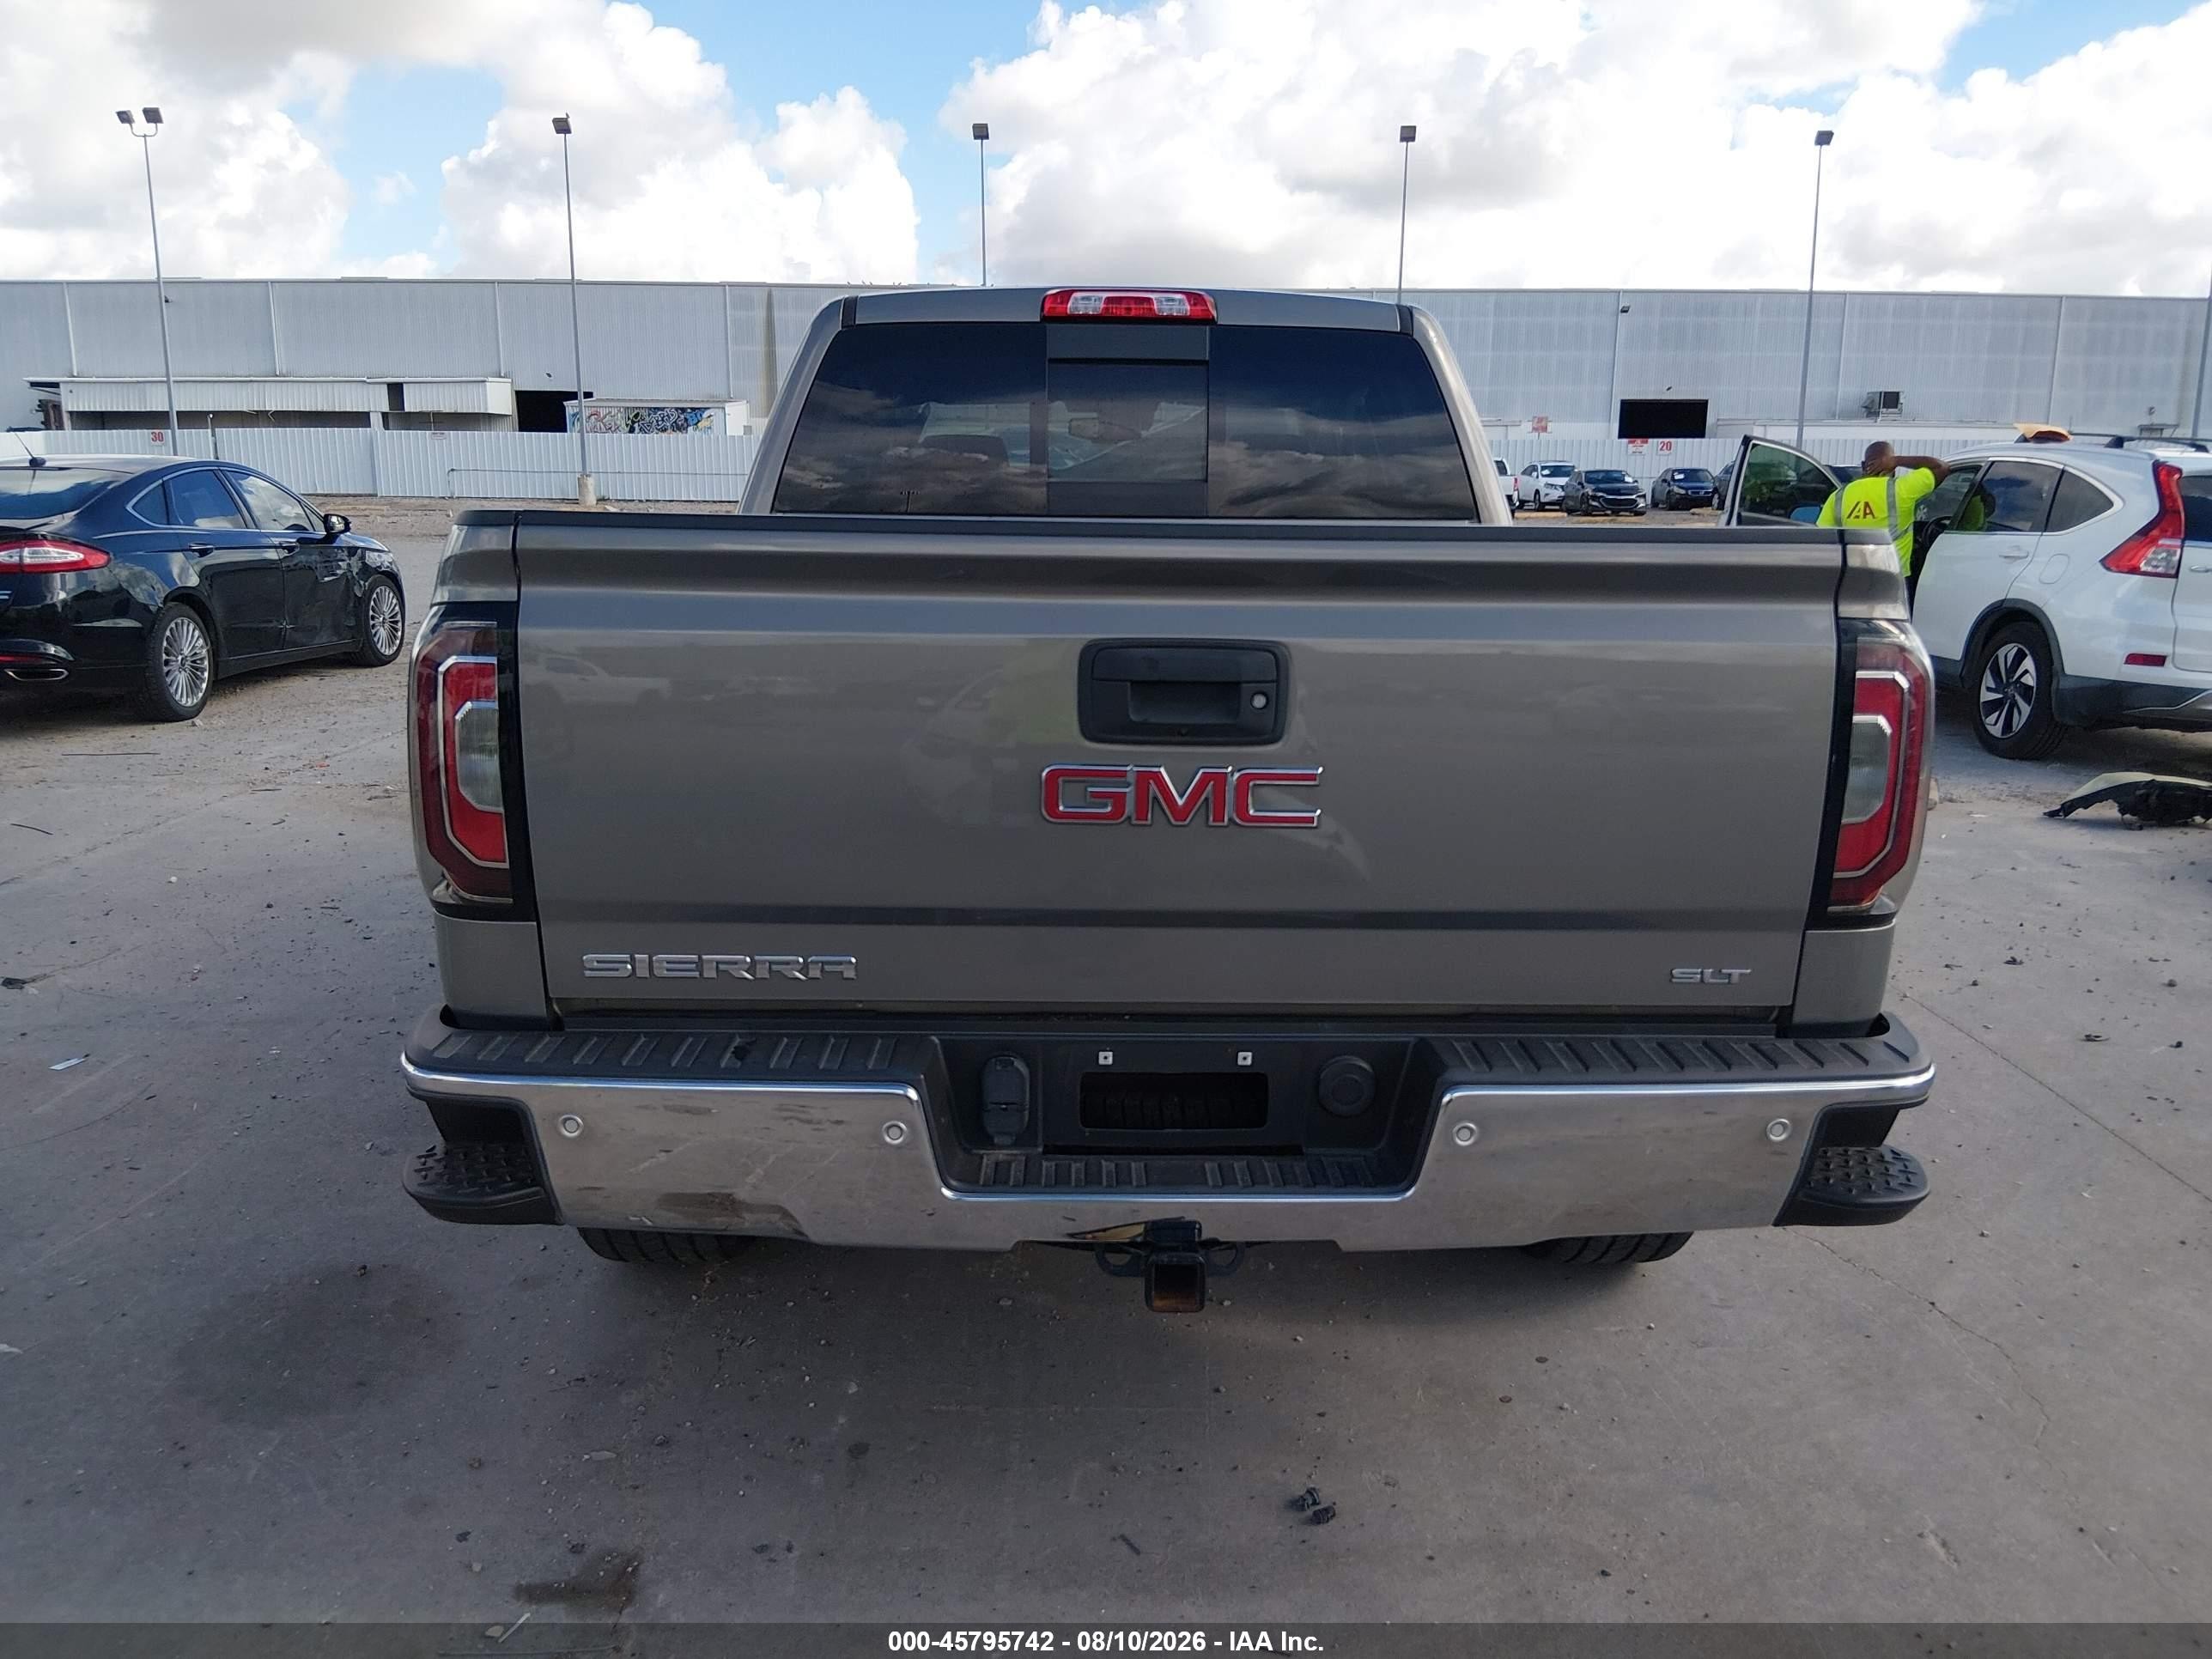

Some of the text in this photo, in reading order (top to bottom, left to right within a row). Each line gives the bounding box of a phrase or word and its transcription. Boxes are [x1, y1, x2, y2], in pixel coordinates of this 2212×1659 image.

[150, 431, 165, 442] 30
[1659, 441, 1672, 452] 20
[1042, 763, 1323, 828] GMC
[582, 954, 857, 981] SIERRA
[1671, 968, 1752, 984] SLT
